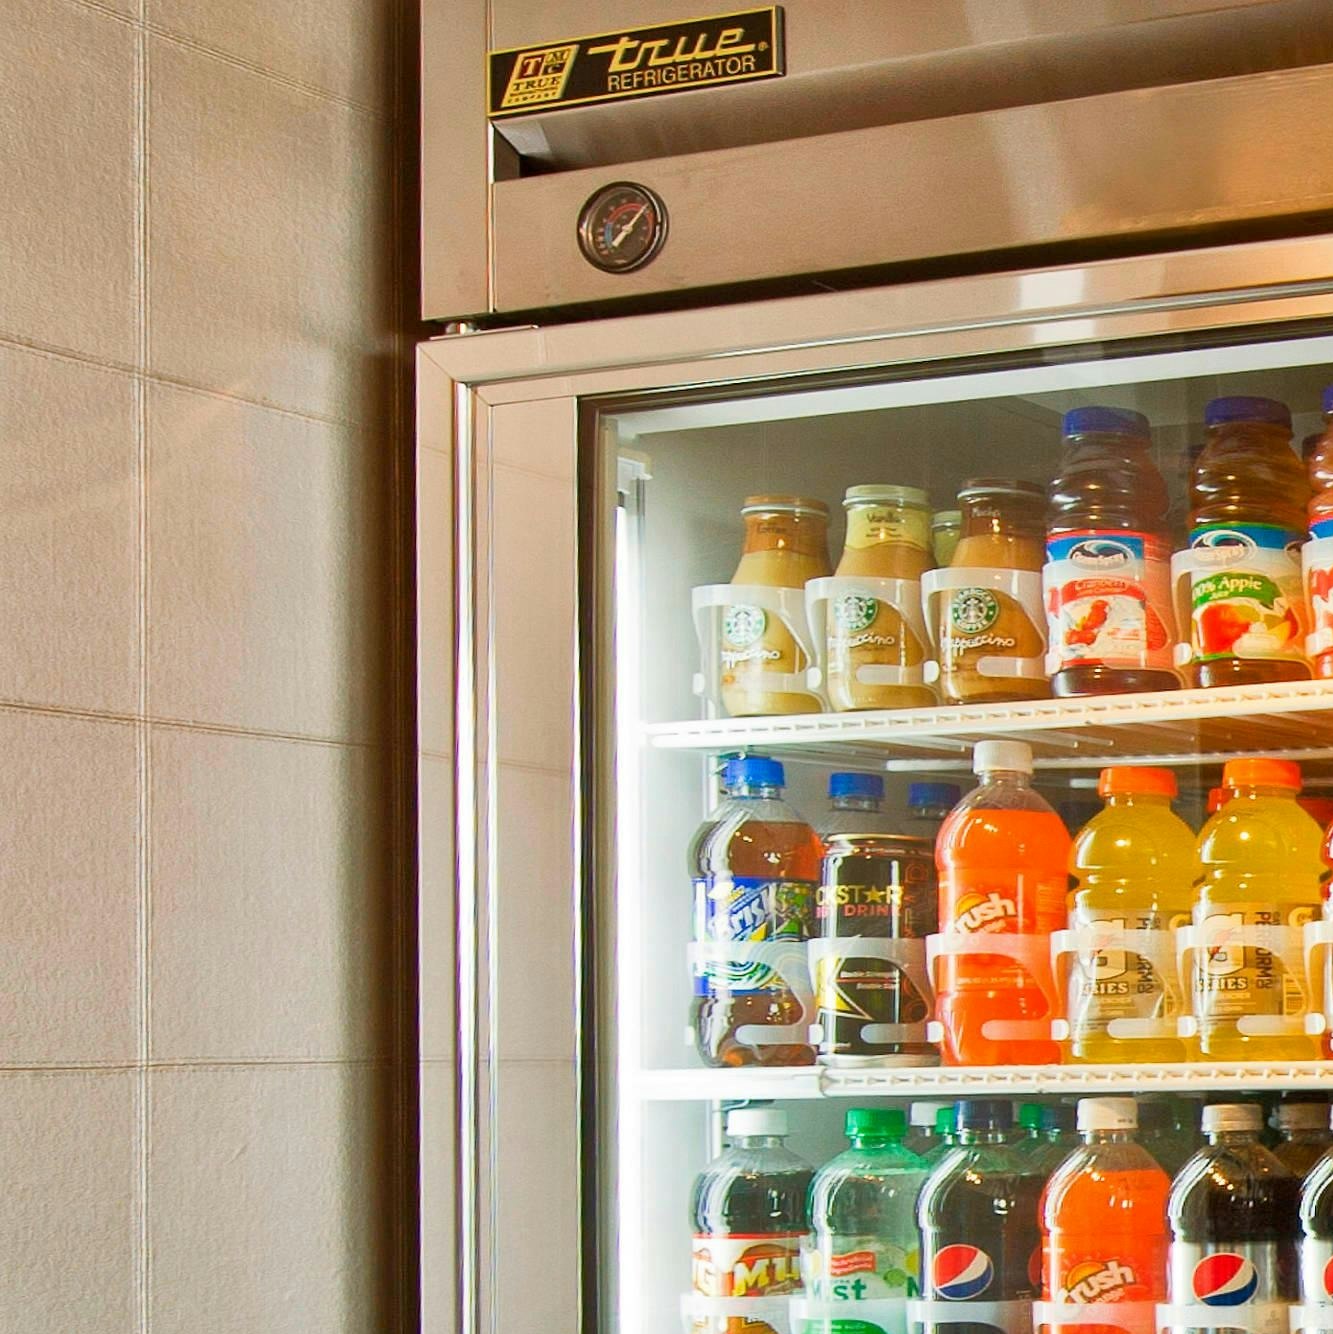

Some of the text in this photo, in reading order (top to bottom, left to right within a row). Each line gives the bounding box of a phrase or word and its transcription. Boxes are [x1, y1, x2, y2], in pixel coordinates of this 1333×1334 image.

[587, 27, 756, 73] true
[512, 77, 561, 93] TRUE
[607, 54, 756, 92] REFRIGERATOR
[1218, 576, 1263, 592] Apple
